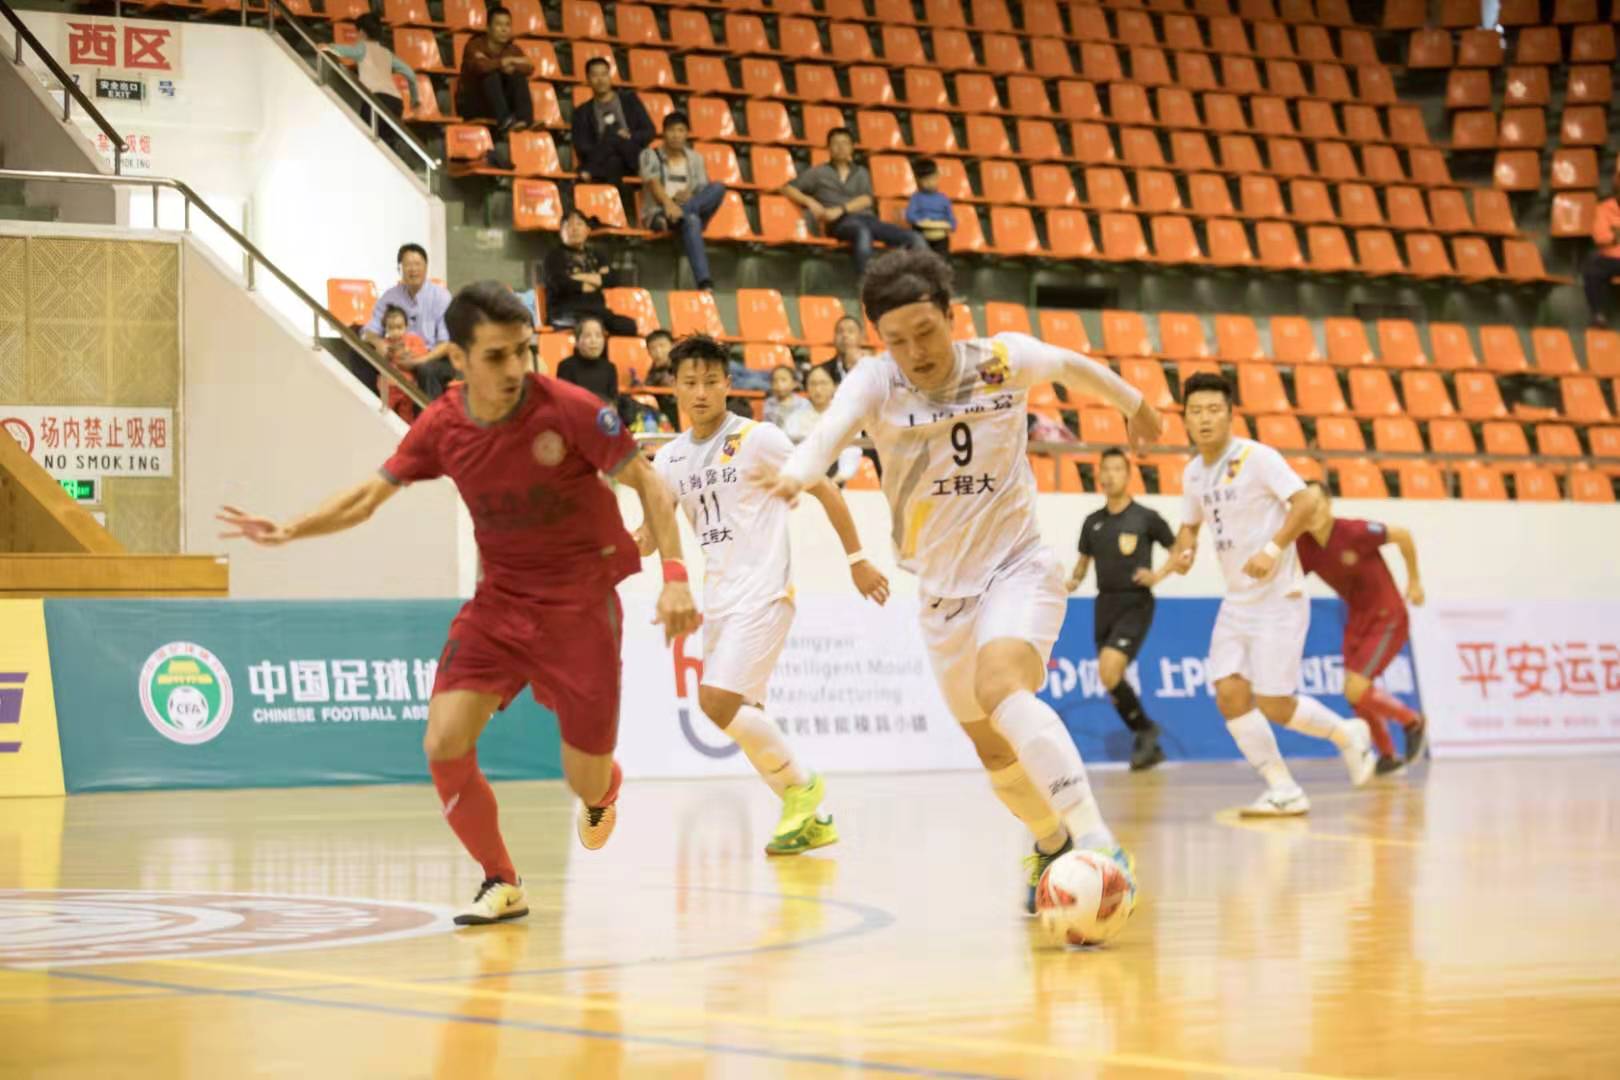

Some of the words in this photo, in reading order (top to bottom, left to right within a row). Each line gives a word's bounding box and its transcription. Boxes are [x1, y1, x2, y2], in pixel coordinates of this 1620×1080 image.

[66, 22, 171, 71] 西区
[100, 80, 138, 91] 安全出口
[107, 90, 131, 98] EXIT
[97, 132, 151, 153] 禁吸烟
[120, 159, 151, 168] MOKING
[40, 416, 167, 449] 场内禁止吸烟
[951, 421, 973, 467] 9
[44, 454, 67, 469] NO
[76, 455, 160, 470] SMOKING
[931, 473, 997, 496] 工程大
[699, 491, 721, 525] 11
[769, 686, 902, 705] Manufacturing
[176, 703, 201, 715] CFA
[253, 708, 316, 723] CHINESE
[321, 706, 396, 721] FOOTBALL
